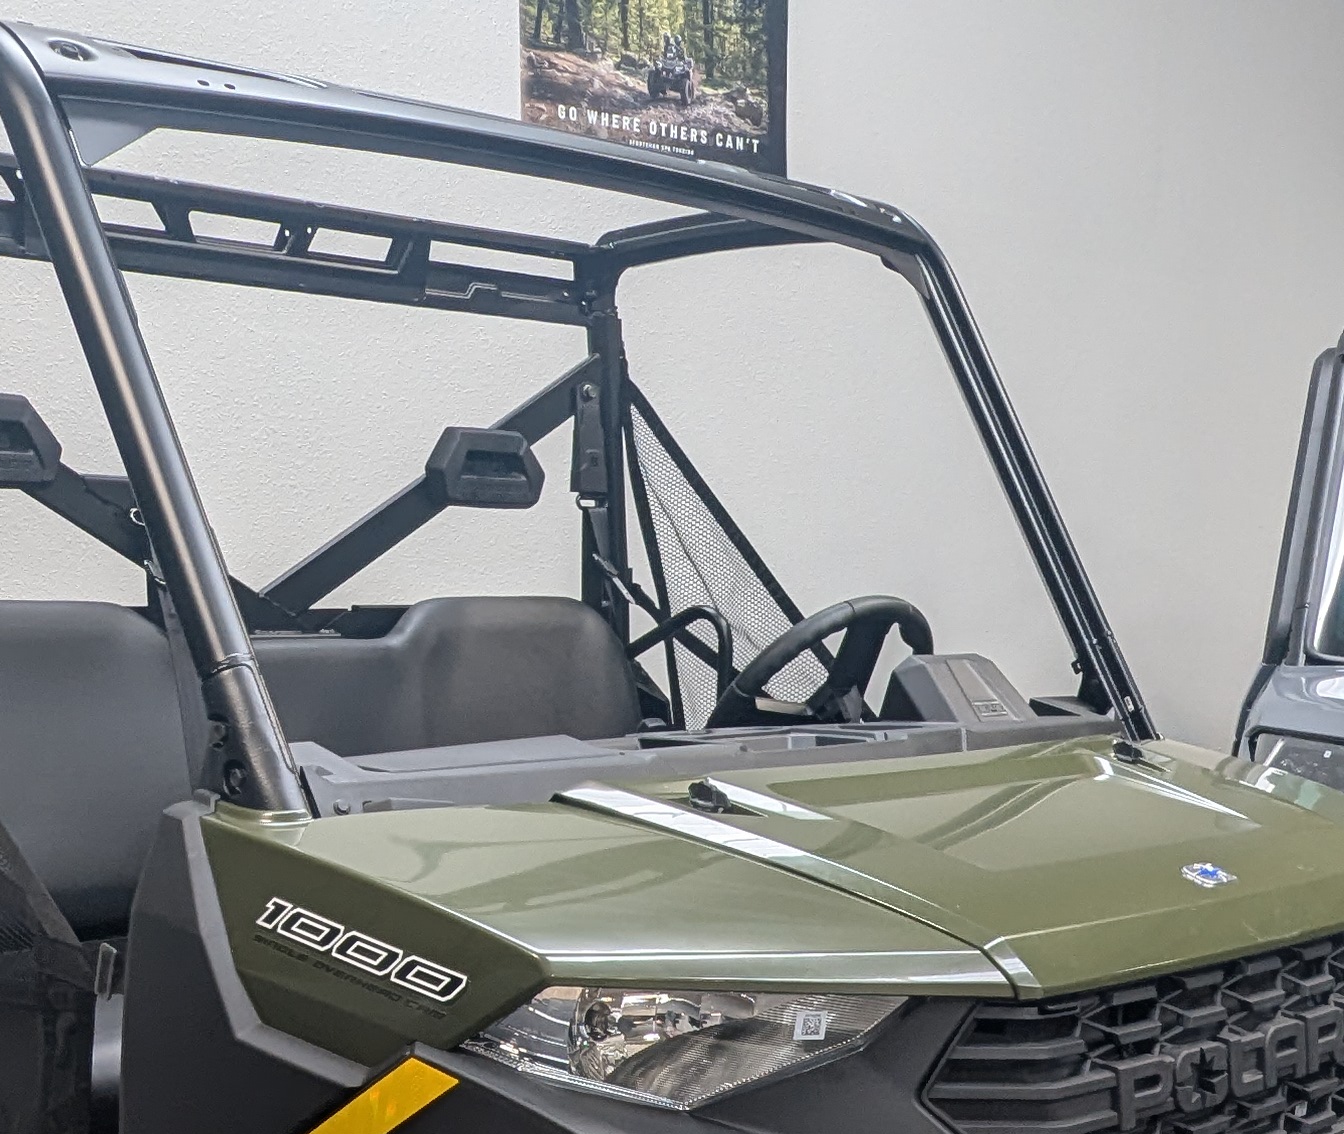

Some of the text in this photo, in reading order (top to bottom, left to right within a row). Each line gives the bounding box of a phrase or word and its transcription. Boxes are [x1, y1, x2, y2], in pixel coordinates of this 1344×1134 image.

[557, 104, 760, 153] GO WHERE OTHERS CAN'T
[256, 897, 468, 1002] 1000
